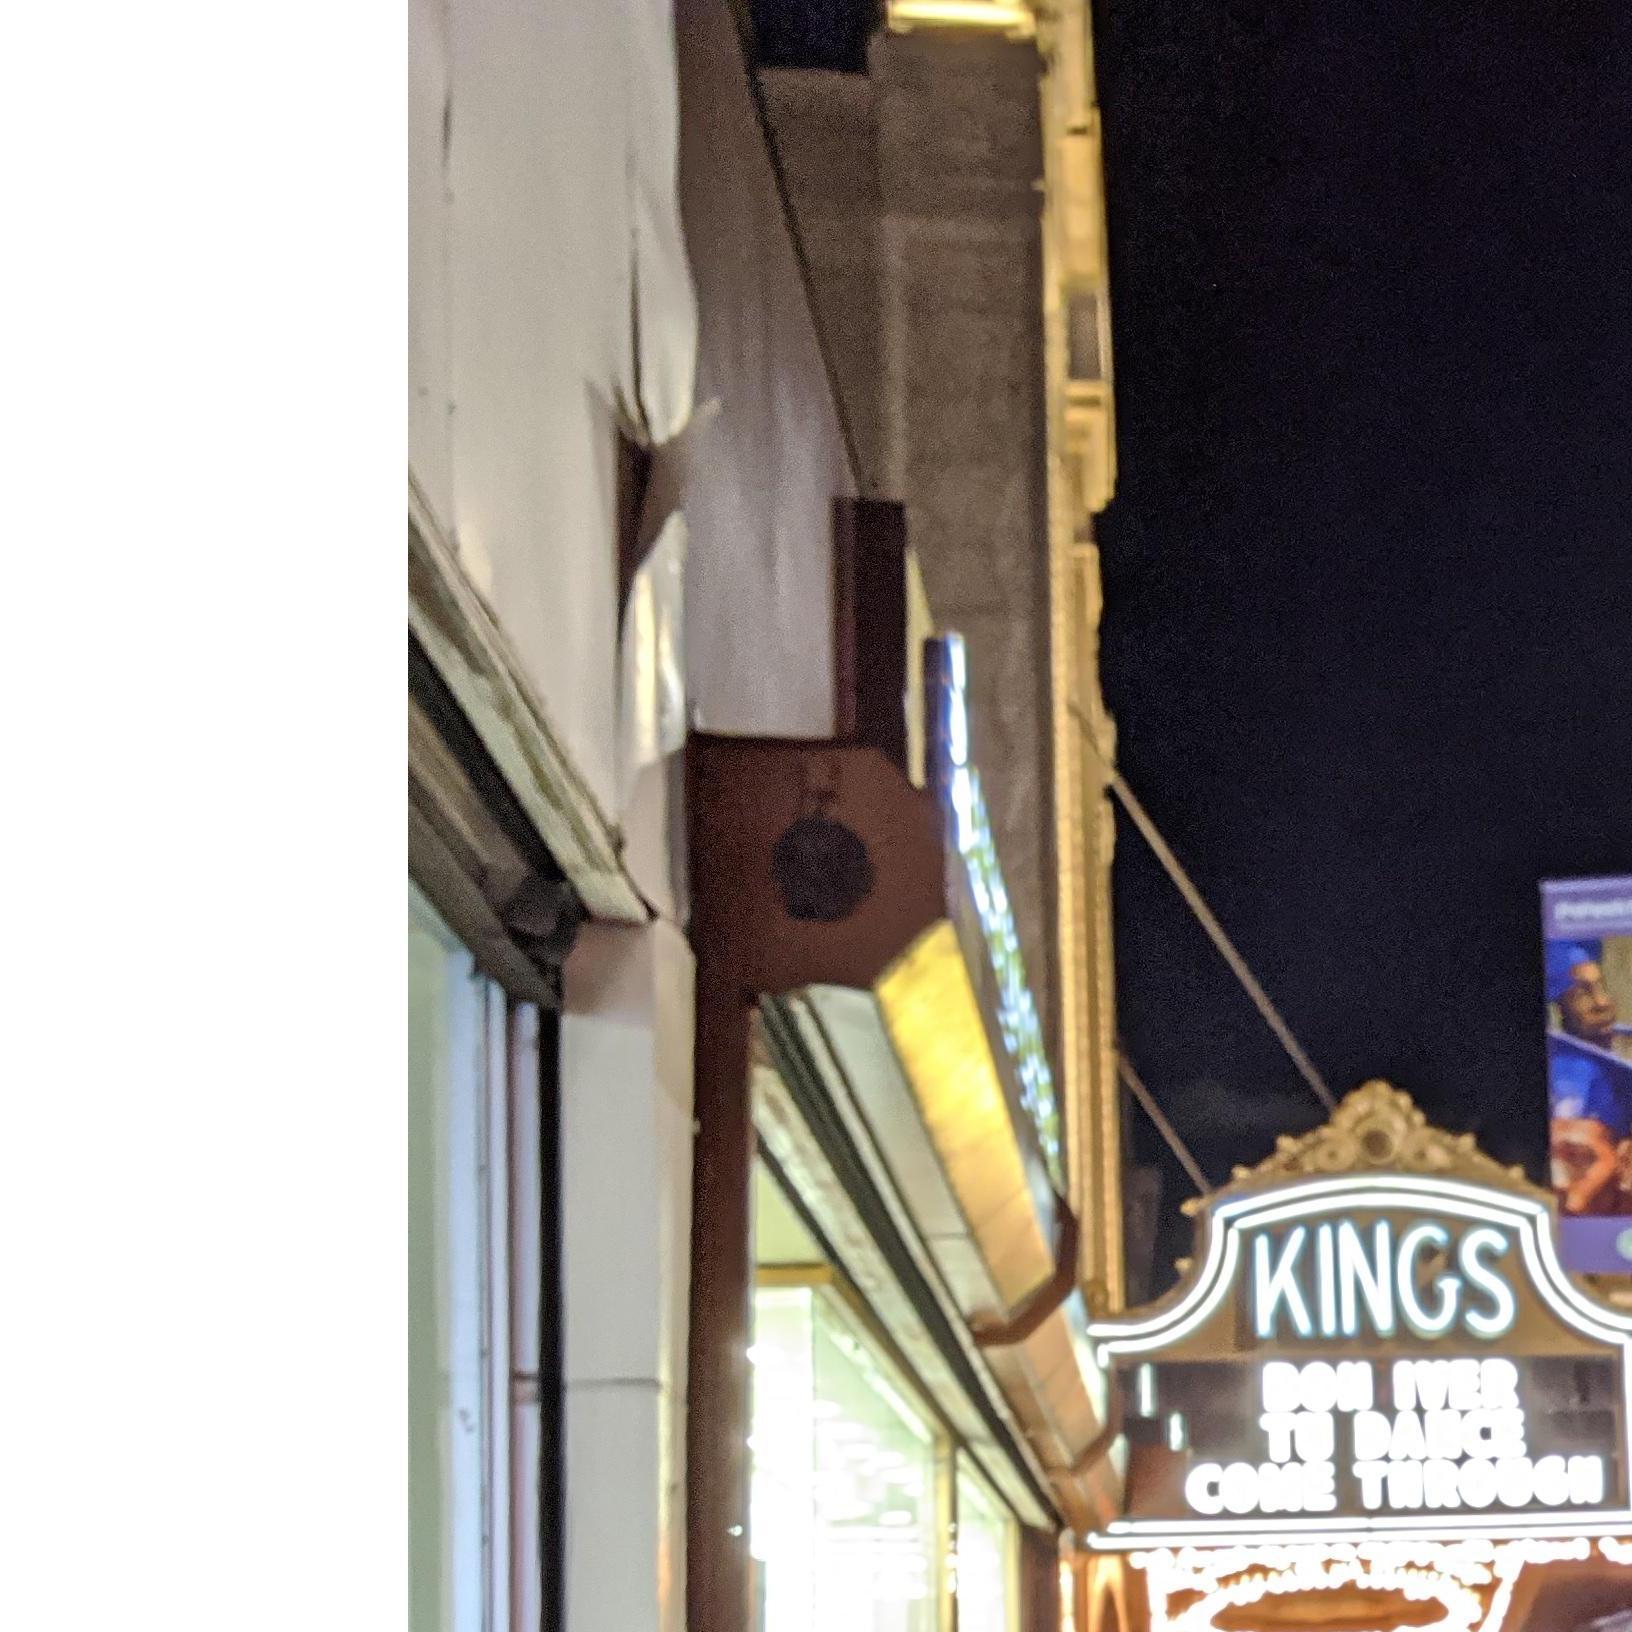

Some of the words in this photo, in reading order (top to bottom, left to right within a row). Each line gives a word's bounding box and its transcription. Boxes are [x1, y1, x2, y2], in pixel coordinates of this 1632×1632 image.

[1254, 1218, 1516, 1340] KINGS
[1392, 1358, 1519, 1412] IVER
[1353, 1407, 1528, 1461] DANCE
[1185, 1462, 1338, 1514] COME
[1353, 1455, 1604, 1510] THROUGH
